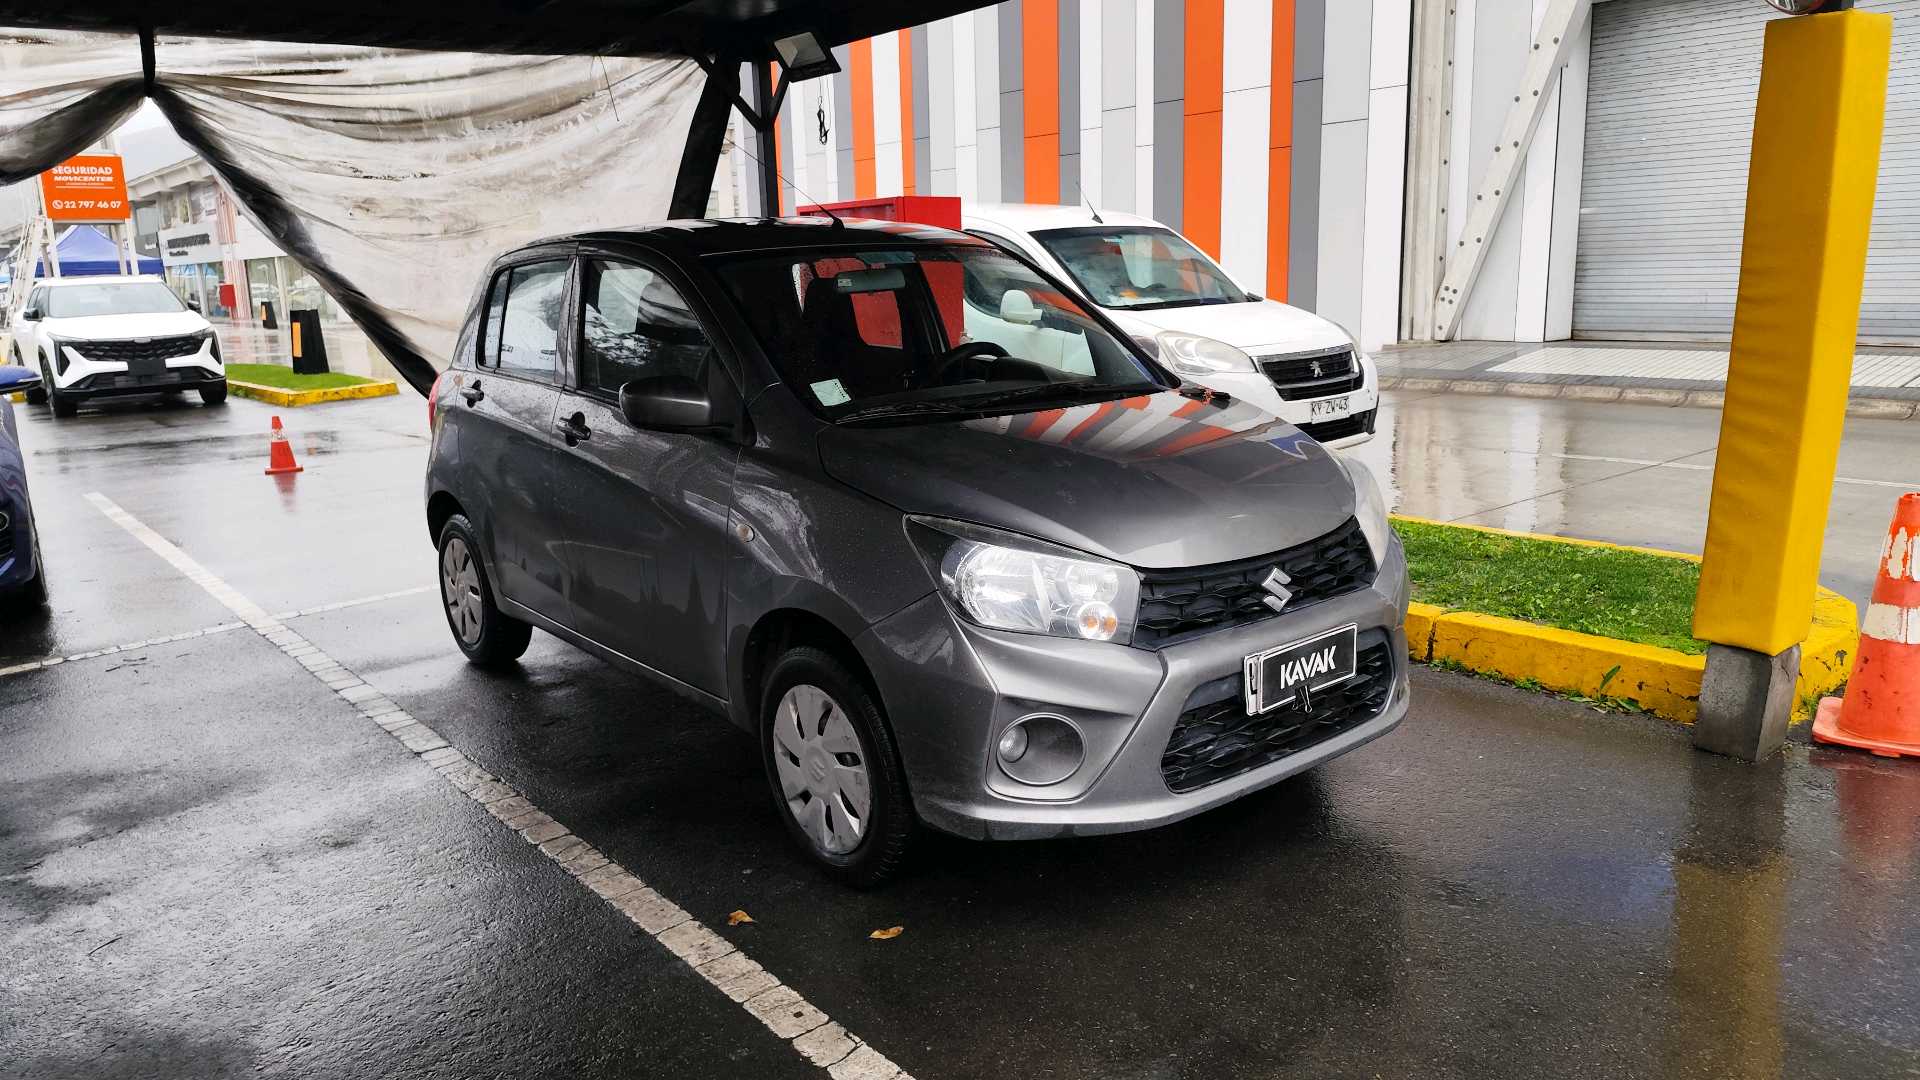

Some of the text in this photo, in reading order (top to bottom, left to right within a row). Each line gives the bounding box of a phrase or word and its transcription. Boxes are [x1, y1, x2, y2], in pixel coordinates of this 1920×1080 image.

[52, 166, 113, 175] SEGURIDAD
[63, 200, 122, 209] 22 797 46 07
[1280, 645, 1337, 690] KAVAK
